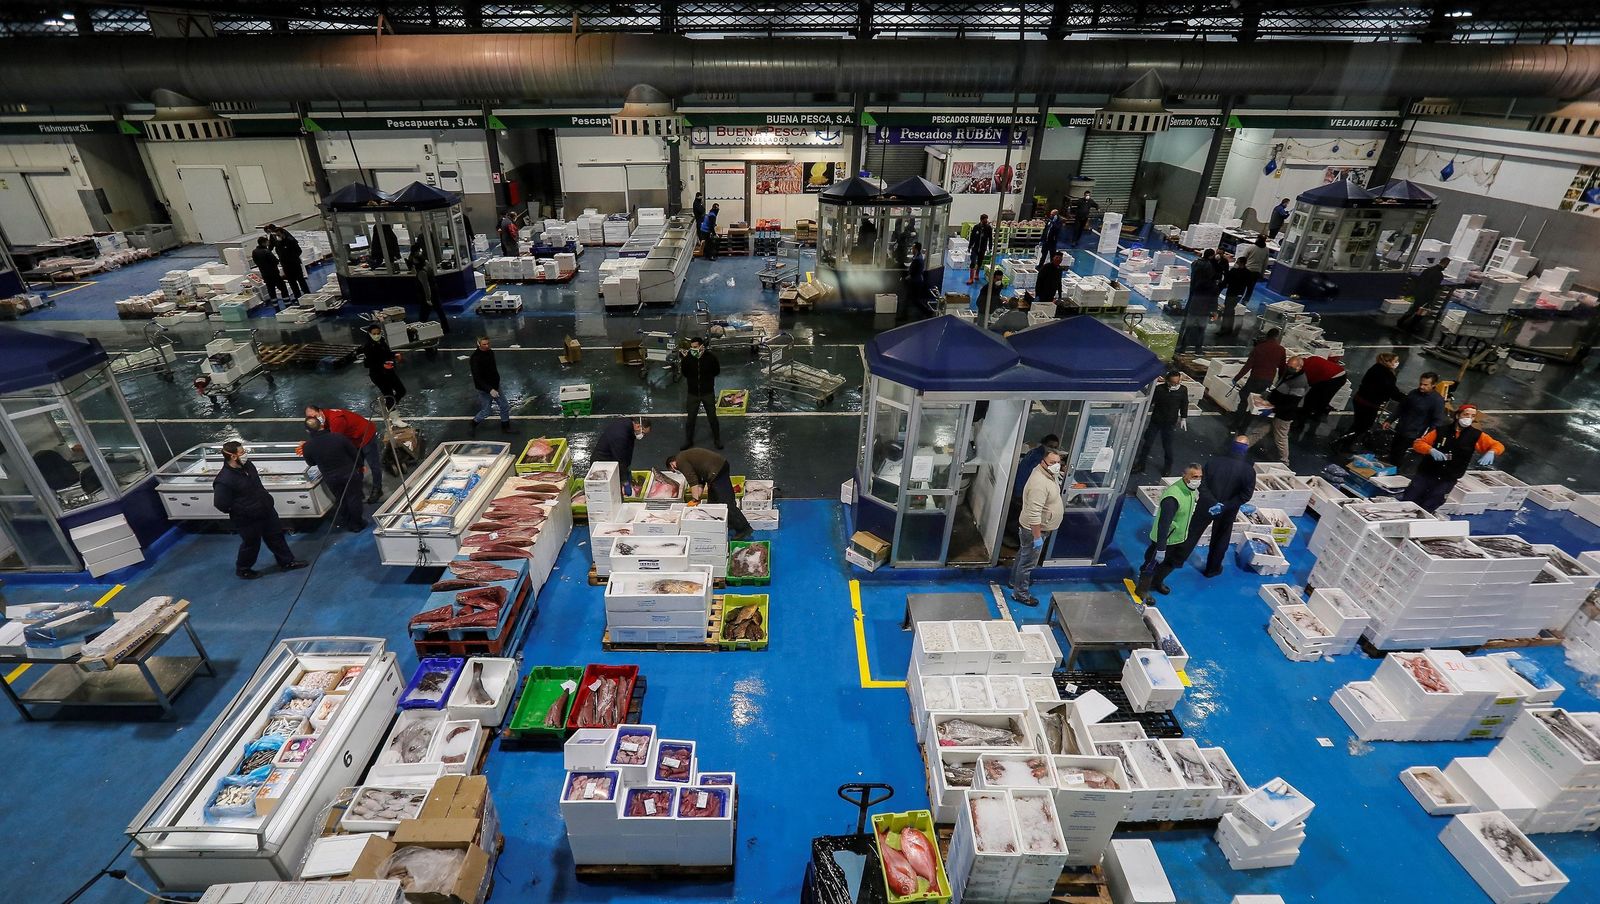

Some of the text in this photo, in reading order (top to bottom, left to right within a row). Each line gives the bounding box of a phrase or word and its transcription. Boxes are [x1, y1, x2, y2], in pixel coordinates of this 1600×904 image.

[386, 118, 450, 128] Pescapuerta
[458, 118, 478, 126] S.A.
[766, 115, 798, 124] BUENA
[800, 115, 834, 126] PESCA,
[836, 115, 854, 124] S.A.
[932, 116, 969, 124] PESCADOS
[970, 114, 994, 124] RUBÉN
[1024, 116, 1038, 124] S.L.
[1170, 117, 1192, 126] Serrano
[1194, 117, 1208, 126] Toro,
[1210, 118, 1221, 126] S.L.
[1330, 119, 1398, 128] VELADAME S.L.
[900, 126, 1002, 140] Pescados RUBÉN
[344, 750, 352, 768] 6
